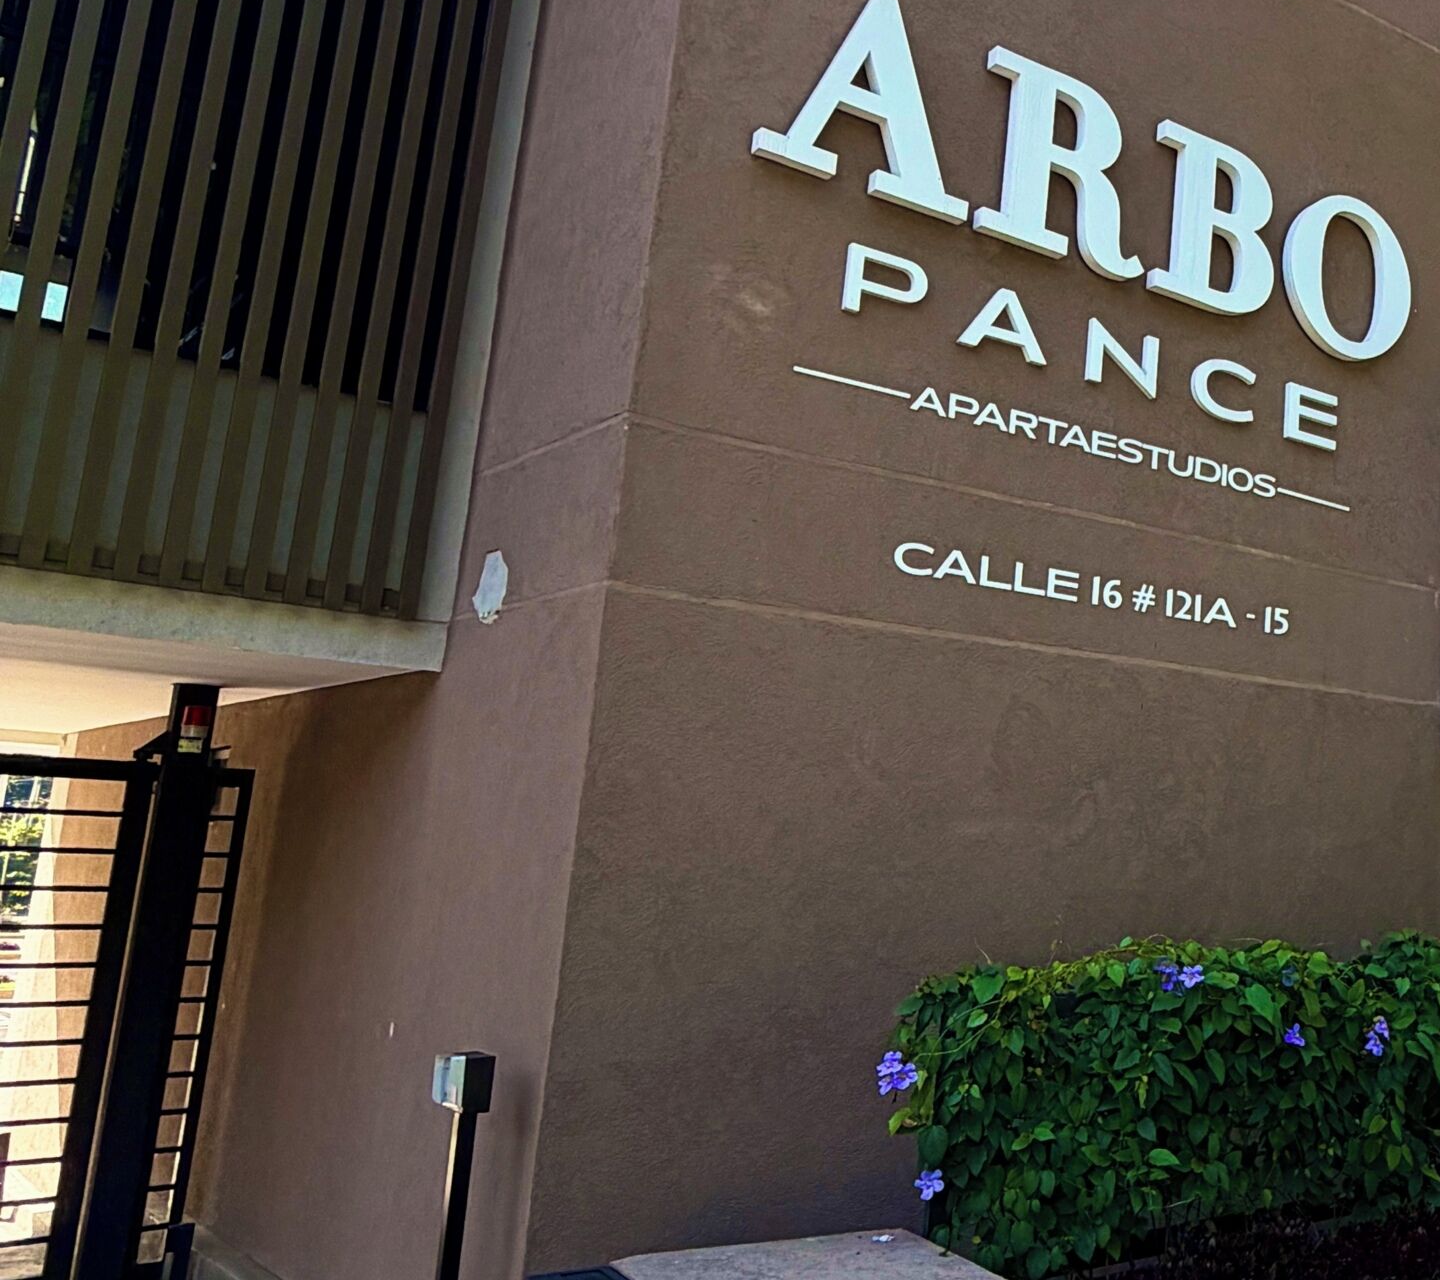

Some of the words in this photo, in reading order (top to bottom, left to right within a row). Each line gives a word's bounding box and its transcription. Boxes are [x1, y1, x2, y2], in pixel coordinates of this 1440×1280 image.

[841, 242, 1339, 451] PANCE
[910, 387, 1277, 498] APARTAESTUDIOS
[893, 542, 1080, 603] CALLE
[1091, 576, 1123, 609] 16
[1132, 584, 1157, 613] #
[1165, 588, 1237, 628] 121A
[1263, 606, 1290, 635] 15
